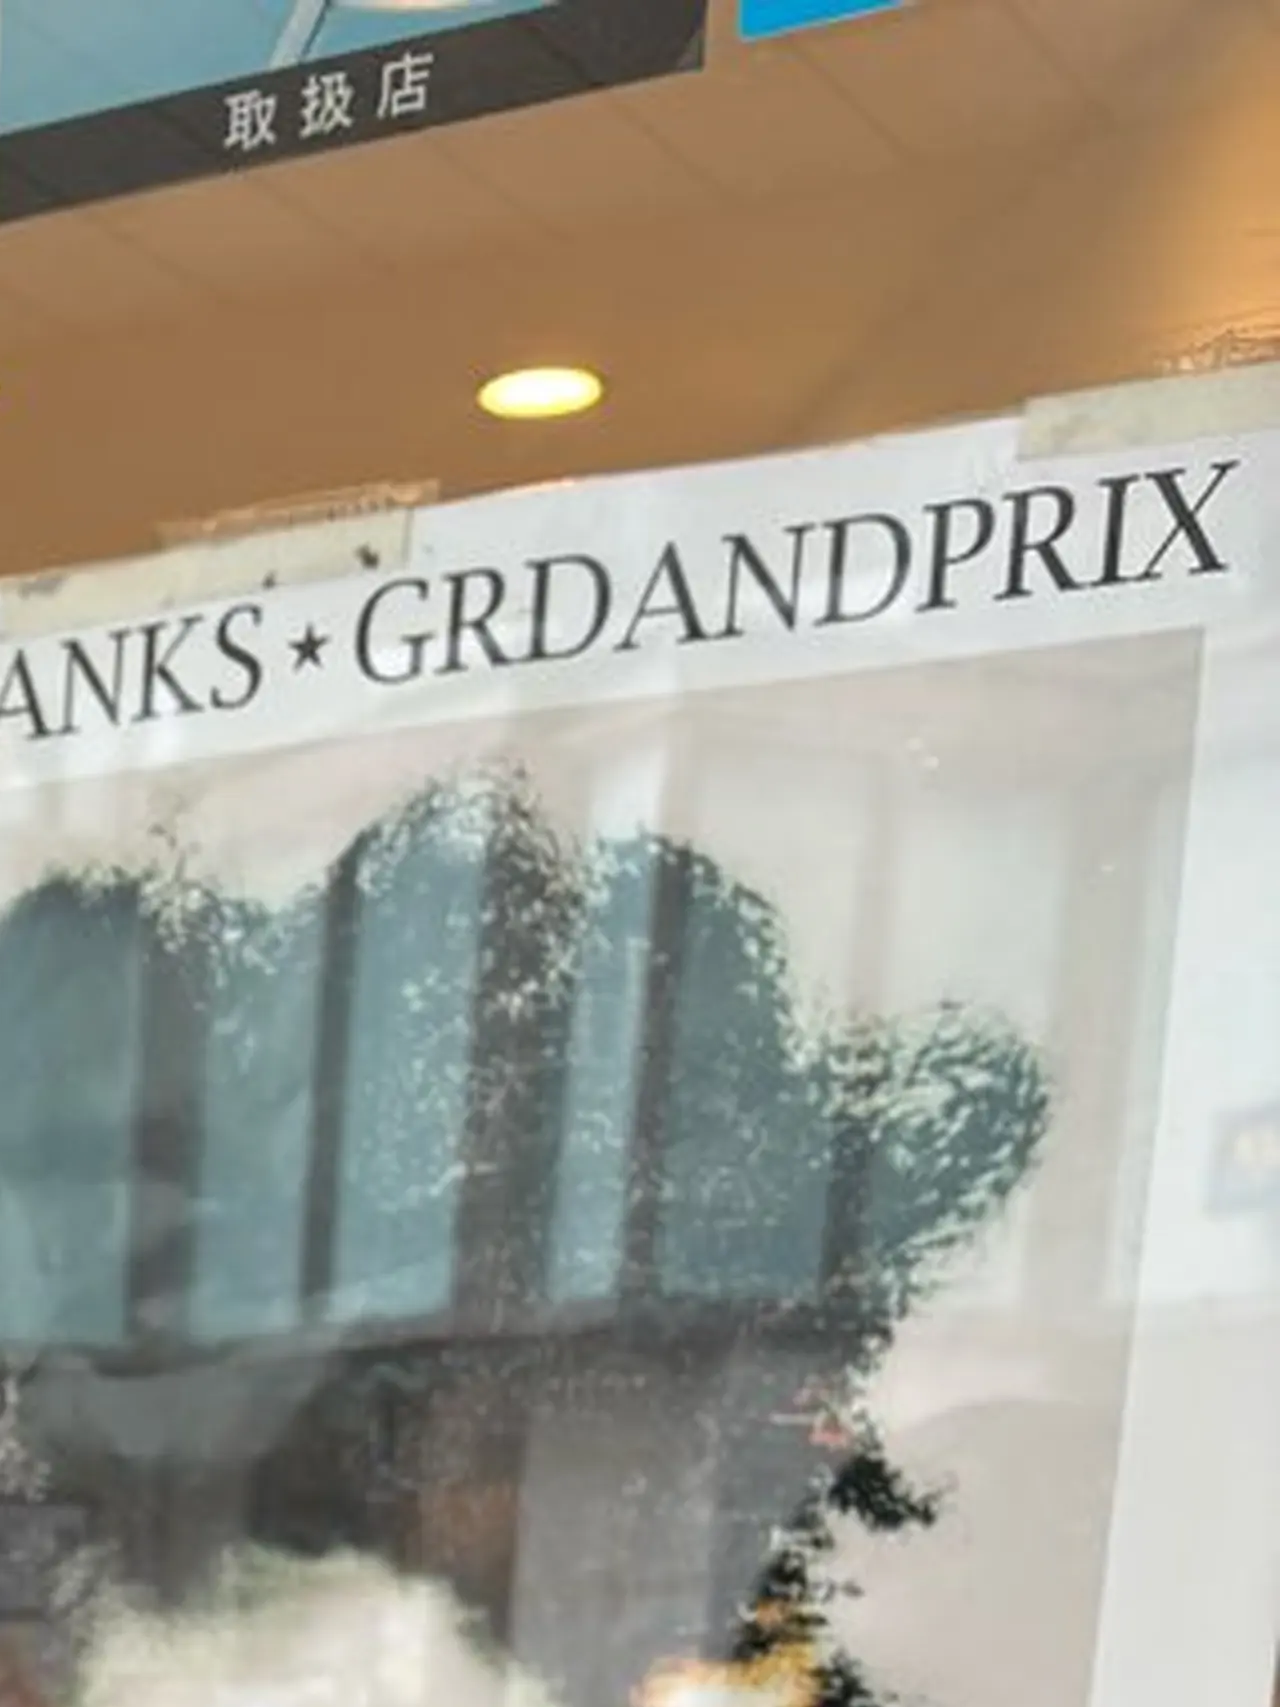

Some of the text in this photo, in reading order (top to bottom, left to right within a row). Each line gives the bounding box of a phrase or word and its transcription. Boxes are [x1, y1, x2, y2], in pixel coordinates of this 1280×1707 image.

[223, 50, 435, 150] 取扱店
[354, 457, 1241, 687] GRDANDPRIX
